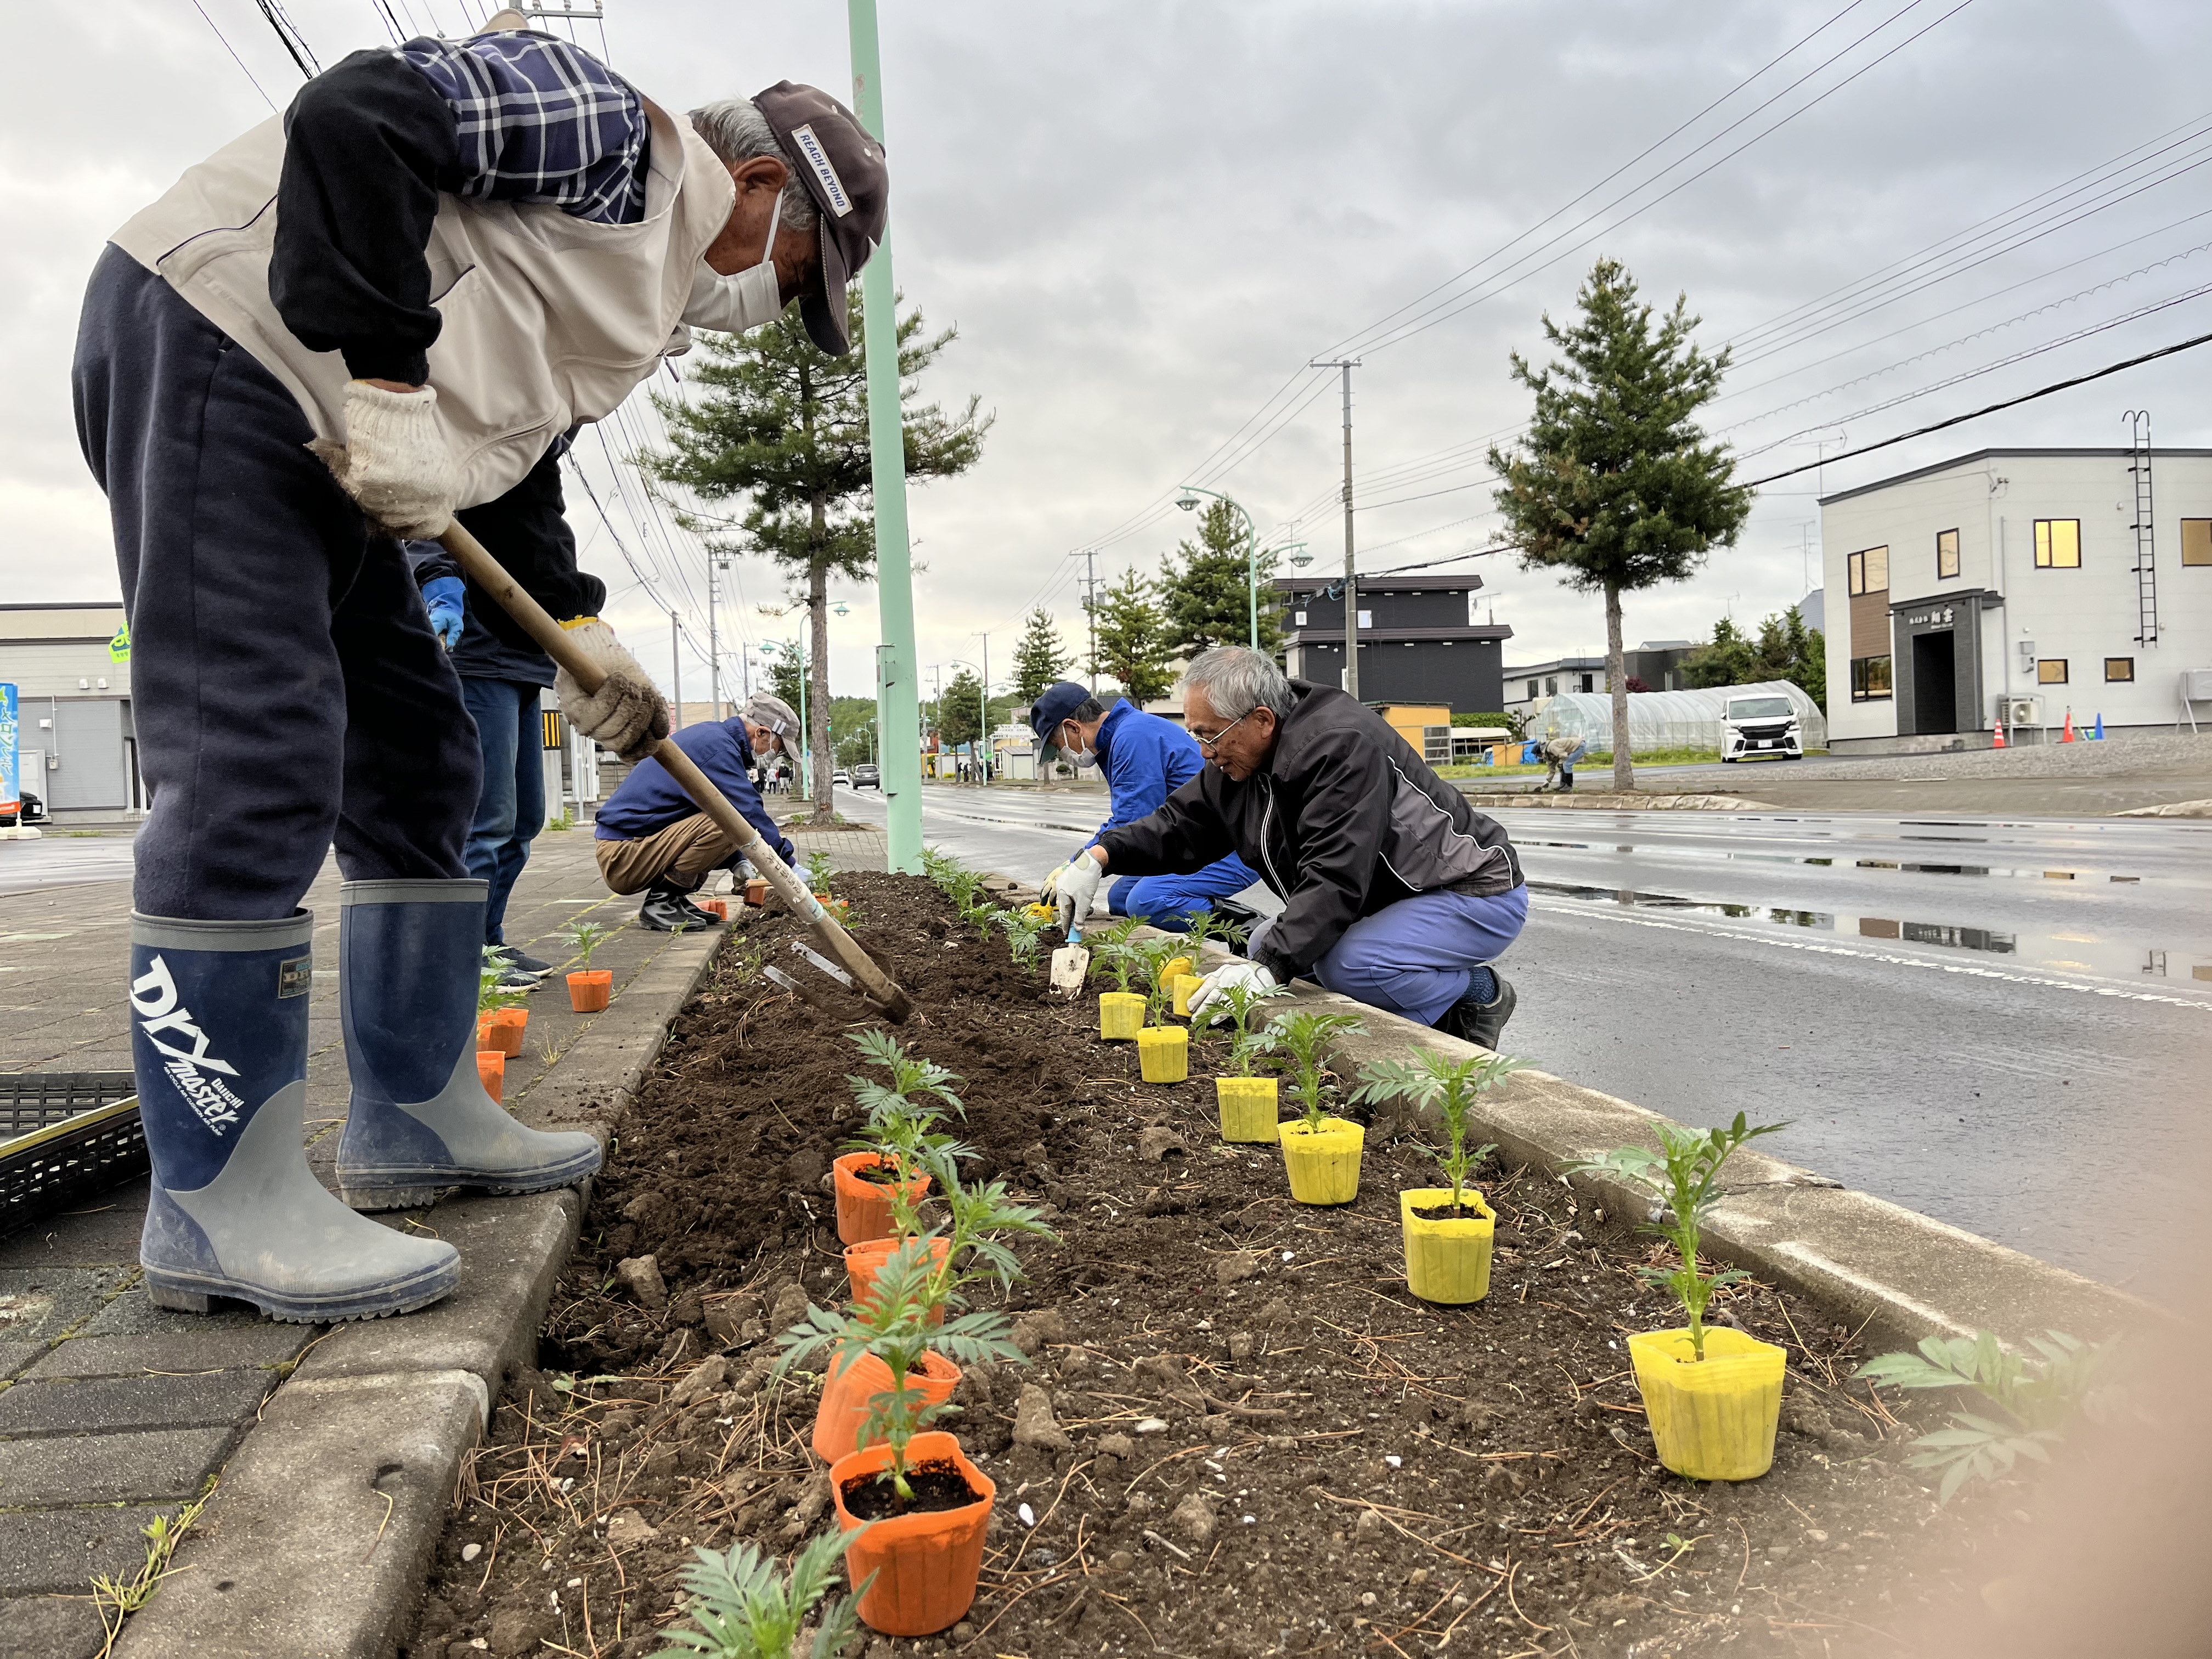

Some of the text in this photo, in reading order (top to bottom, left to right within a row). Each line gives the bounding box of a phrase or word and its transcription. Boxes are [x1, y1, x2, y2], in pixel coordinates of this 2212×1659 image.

[800, 134, 845, 207] REACH BEYOND
[169, 1074, 182, 1090] CYCLE
[187, 1097, 204, 1118] CUSHION
[202, 1118, 211, 1126] AIR
[210, 1124, 223, 1136] PUMP
[211, 1077, 245, 1109] DAIICHI
